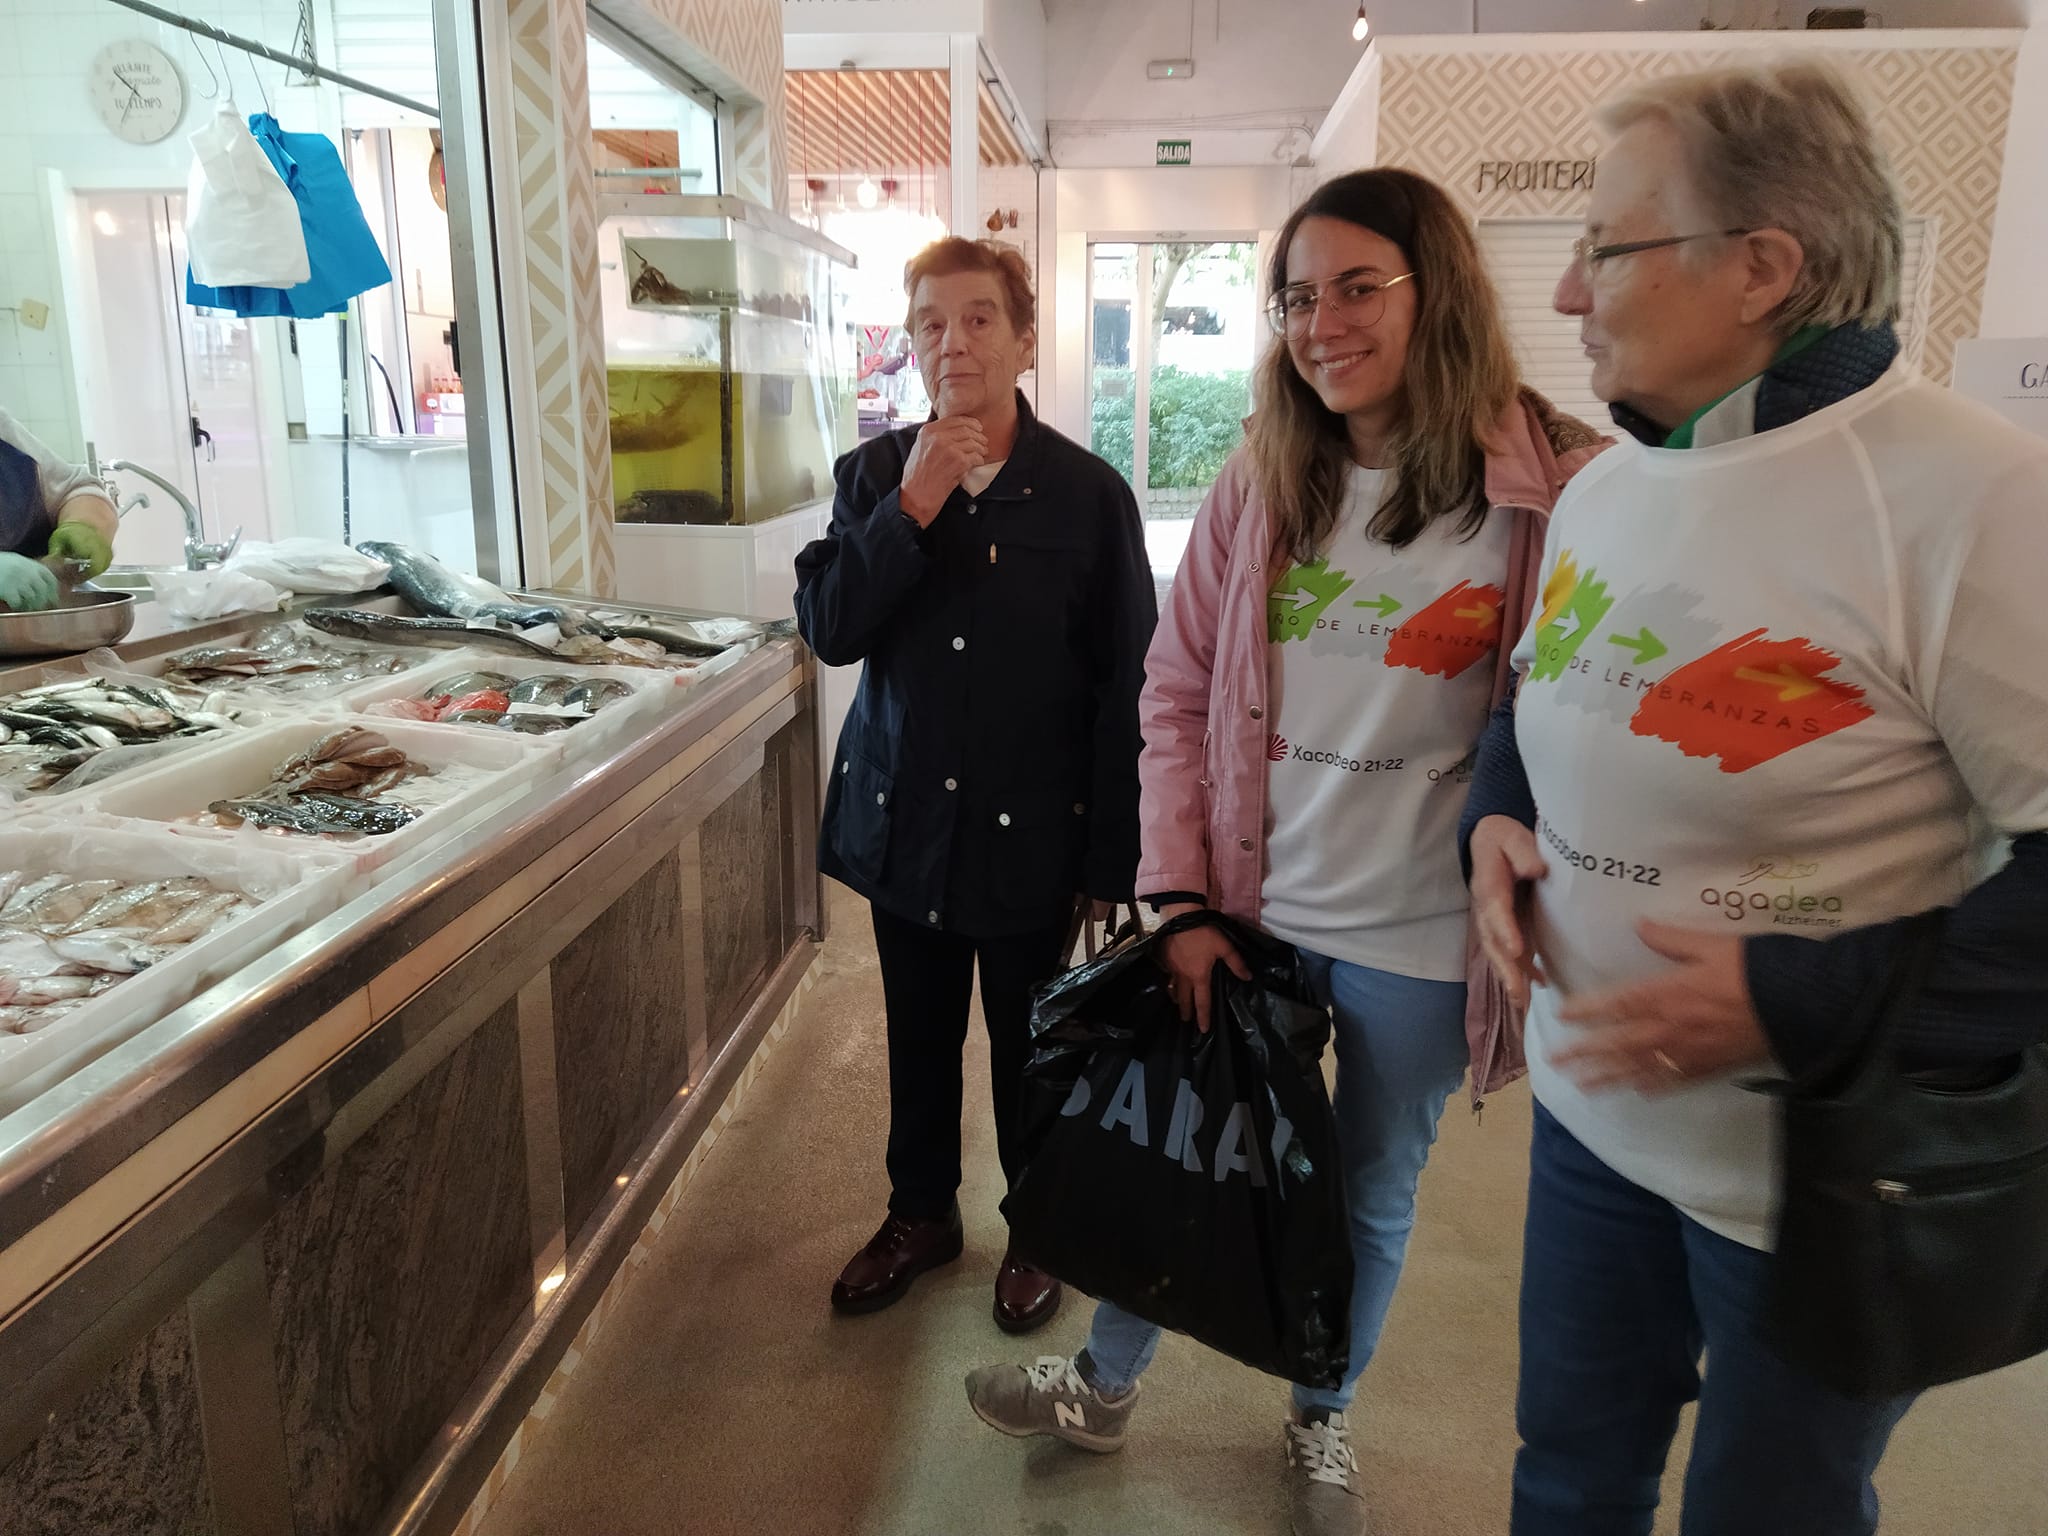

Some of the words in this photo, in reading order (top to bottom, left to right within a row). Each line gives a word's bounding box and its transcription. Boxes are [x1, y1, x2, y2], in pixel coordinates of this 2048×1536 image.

[1157, 144, 1190, 162] SALIDA
[1476, 155, 1597, 193] FROITERÍ
[1273, 612, 1300, 626] ÑO
[1316, 618, 1341, 631] DE
[1358, 623, 1498, 649] LEMBRANZAS
[1569, 655, 1593, 674] DE
[1604, 667, 1821, 735] LEMBRANZAS
[1292, 744, 1360, 772] Xacobeo
[1700, 885, 1842, 921] agadea
[1772, 914, 1843, 929] Alzheimer
[1054, 1401, 1086, 1427] N
